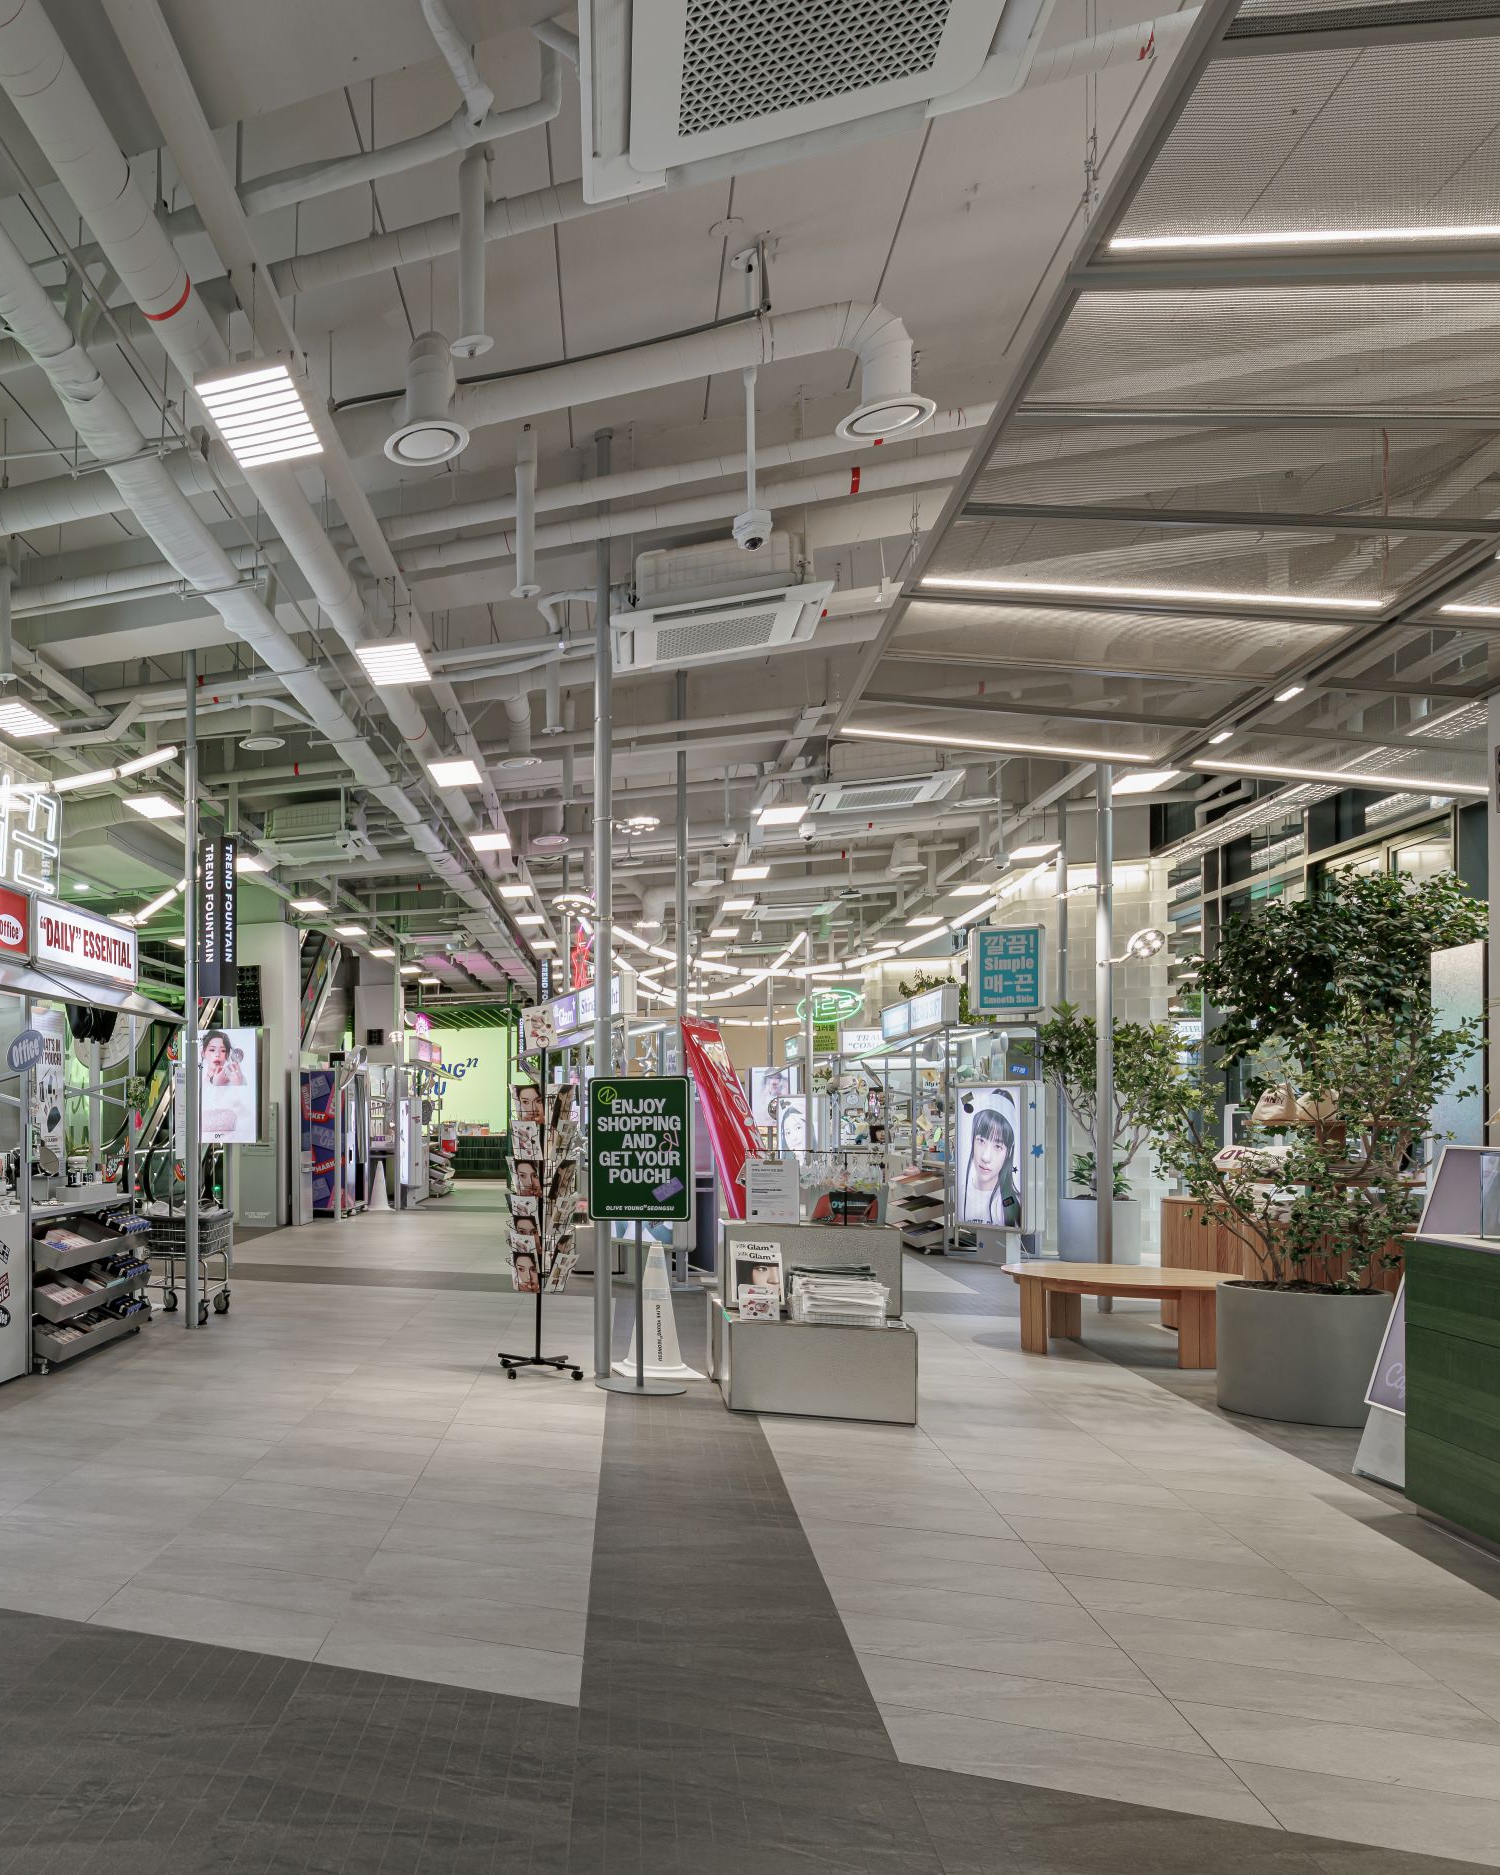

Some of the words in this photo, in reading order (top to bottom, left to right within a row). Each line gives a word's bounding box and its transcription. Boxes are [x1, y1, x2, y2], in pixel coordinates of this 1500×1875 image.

[0, 920, 19, 939] Office
[84, 930, 131, 968] ESSENTIAL
[984, 934, 1034, 955] 깔끔!
[985, 957, 1034, 972] Simple
[984, 974, 1034, 993] 매-끈
[12, 1041, 39, 1067] Office
[612, 1099, 666, 1114] ENJOY
[598, 1116, 681, 1131] SHOPPING
[622, 1134, 656, 1148] AND
[599, 1151, 632, 1166] GET
[635, 1151, 680, 1166] YOUR
[609, 1168, 670, 1184] POUCH!
[749, 1252, 772, 1260] Glam
